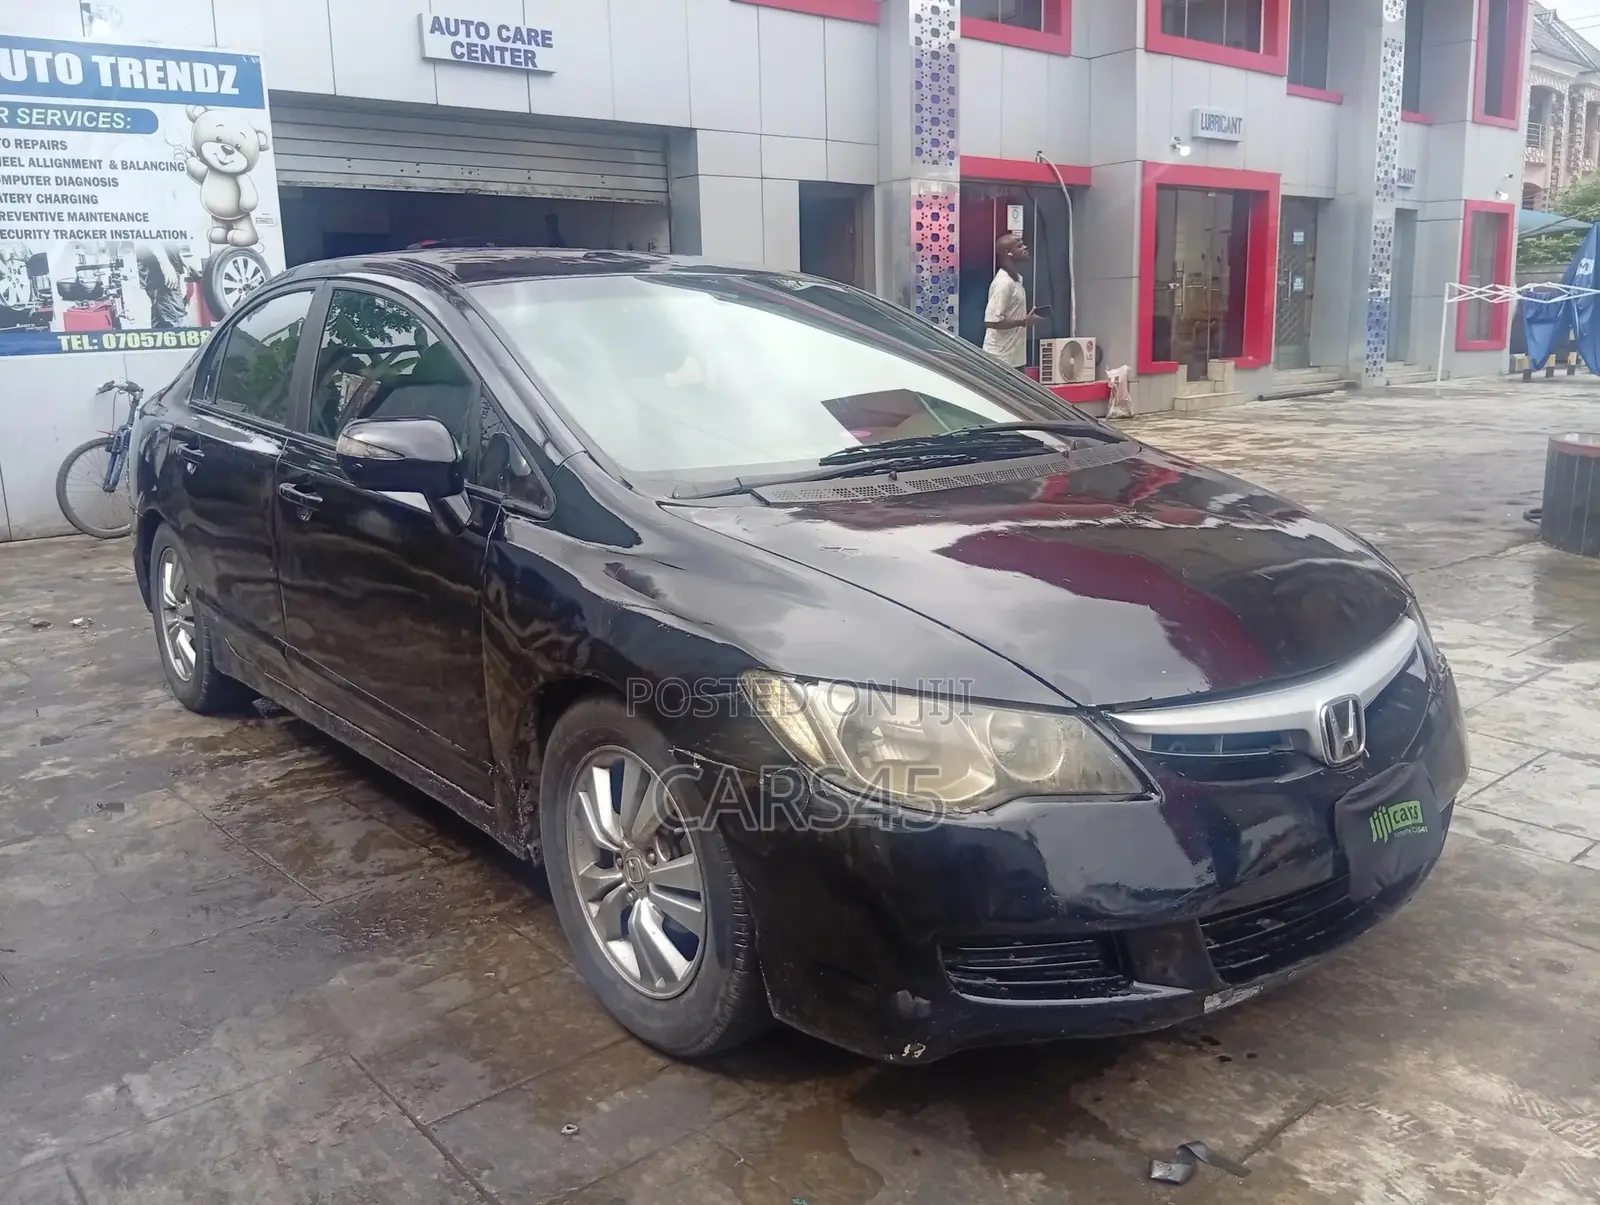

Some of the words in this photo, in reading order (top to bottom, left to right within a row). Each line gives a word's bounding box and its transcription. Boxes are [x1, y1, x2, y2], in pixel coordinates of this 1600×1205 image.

[429, 15, 490, 40] AUTO
[497, 24, 553, 48] CARE
[450, 40, 538, 68] CENTER
[91, 55, 240, 95] TRENDZ
[16, 107, 132, 129] SERVICES:
[1200, 112, 1243, 134] LUBRICANT
[0, 137, 11, 149] O
[14, 138, 68, 151] REPAIRS
[28, 157, 103, 170] ALLIGNMENT
[109, 159, 118, 170] &
[120, 160, 186, 172] BALANCING
[0, 174, 52, 187] MPUTER
[55, 175, 120, 188] DIAGNOSIS
[36, 193, 99, 205] CHARGING
[67, 212, 150, 223] MAINTENANCE
[53, 229, 107, 240] TRACKER
[110, 229, 188, 240] INSTALLATION
[57, 334, 99, 351] TEL:
